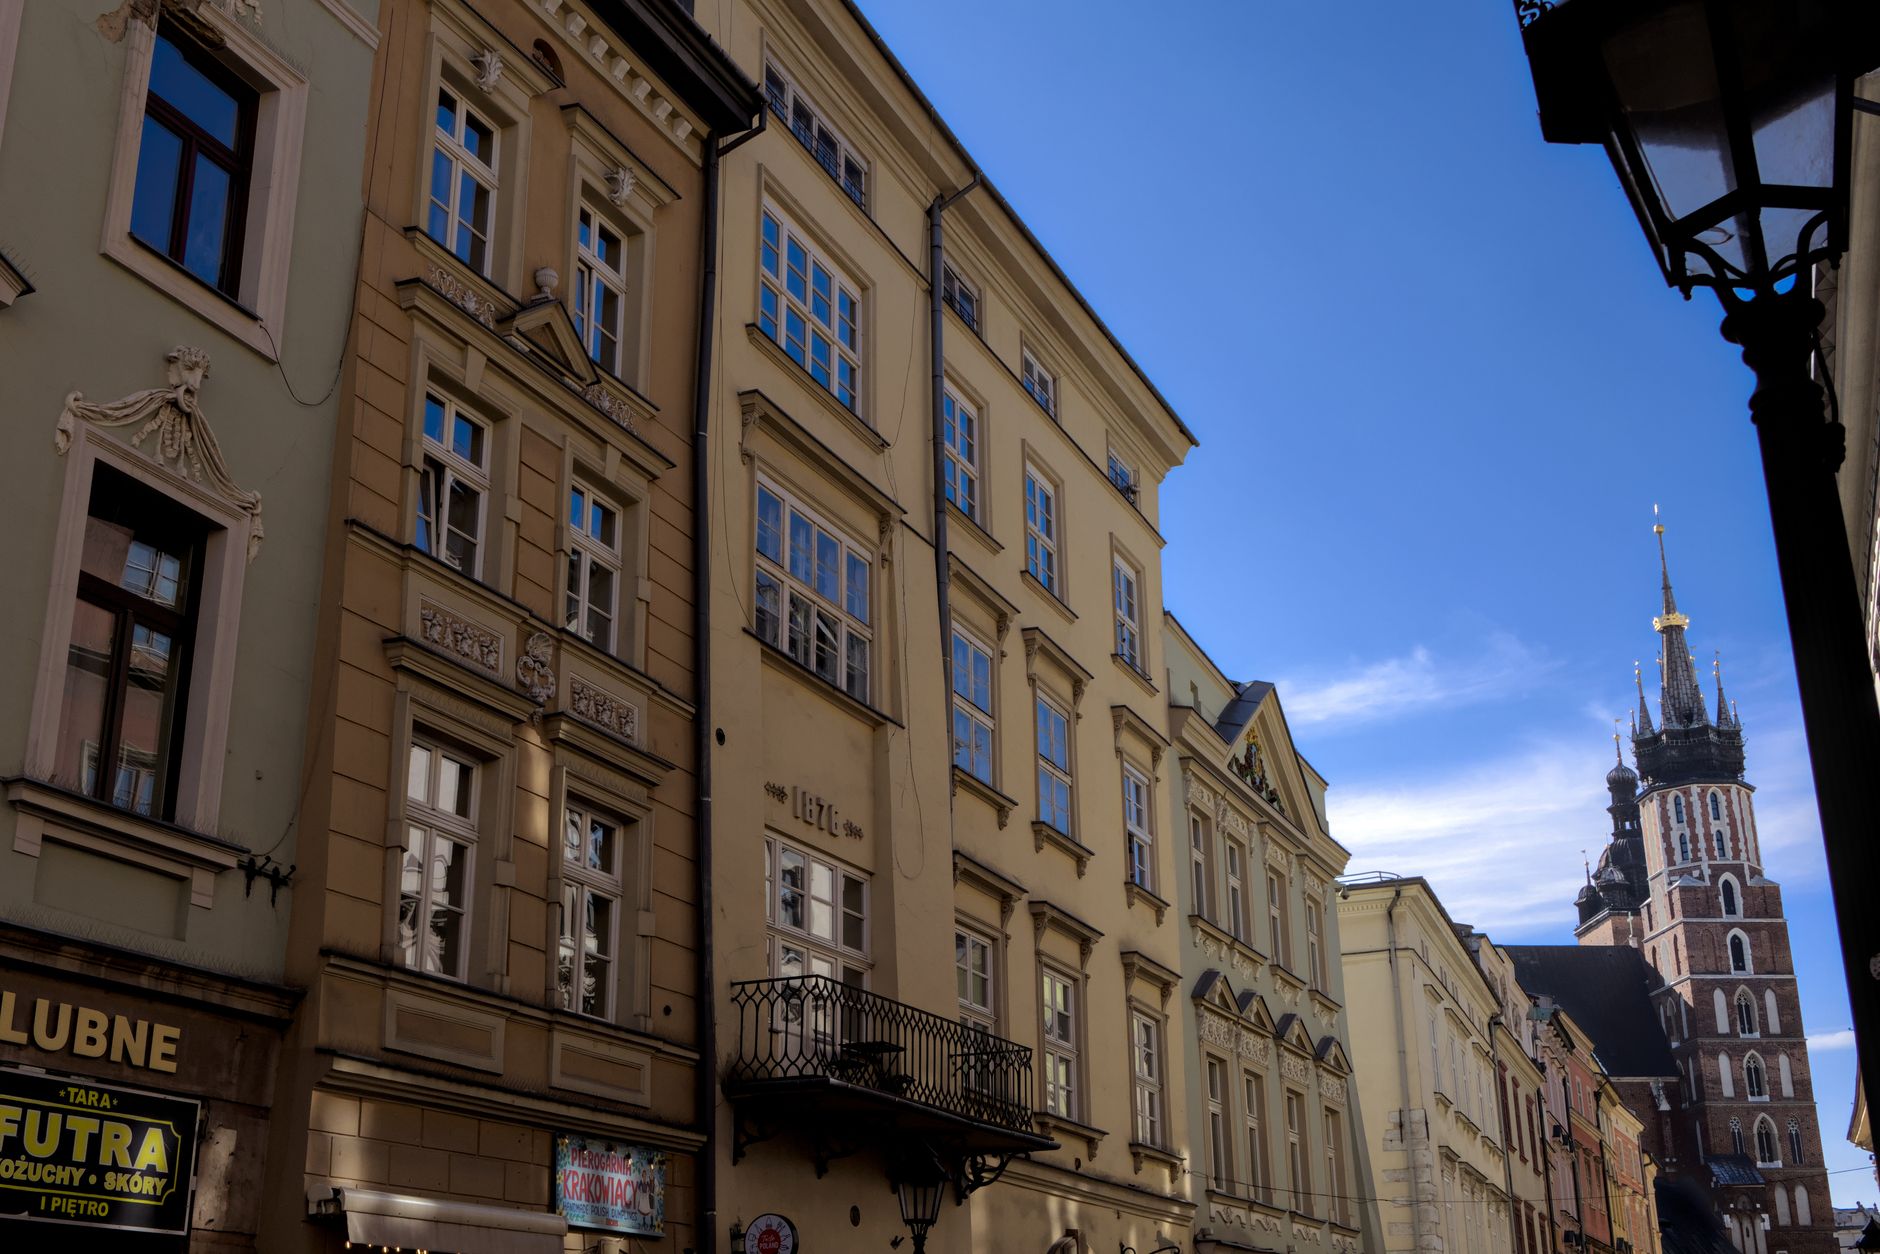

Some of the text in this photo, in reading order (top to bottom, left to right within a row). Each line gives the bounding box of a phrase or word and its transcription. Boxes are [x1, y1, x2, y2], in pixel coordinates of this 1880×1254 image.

[0, 991, 181, 1073] LUBNE
[0, 1105, 169, 1173] FUTRA
[0, 1155, 167, 1196] OŻUCHY SKÓRY
[571, 1148, 632, 1176] PIEROGARNIA
[40, 1196, 109, 1218] I PIĘTRO
[563, 1169, 638, 1210] KRAKOWIACY
